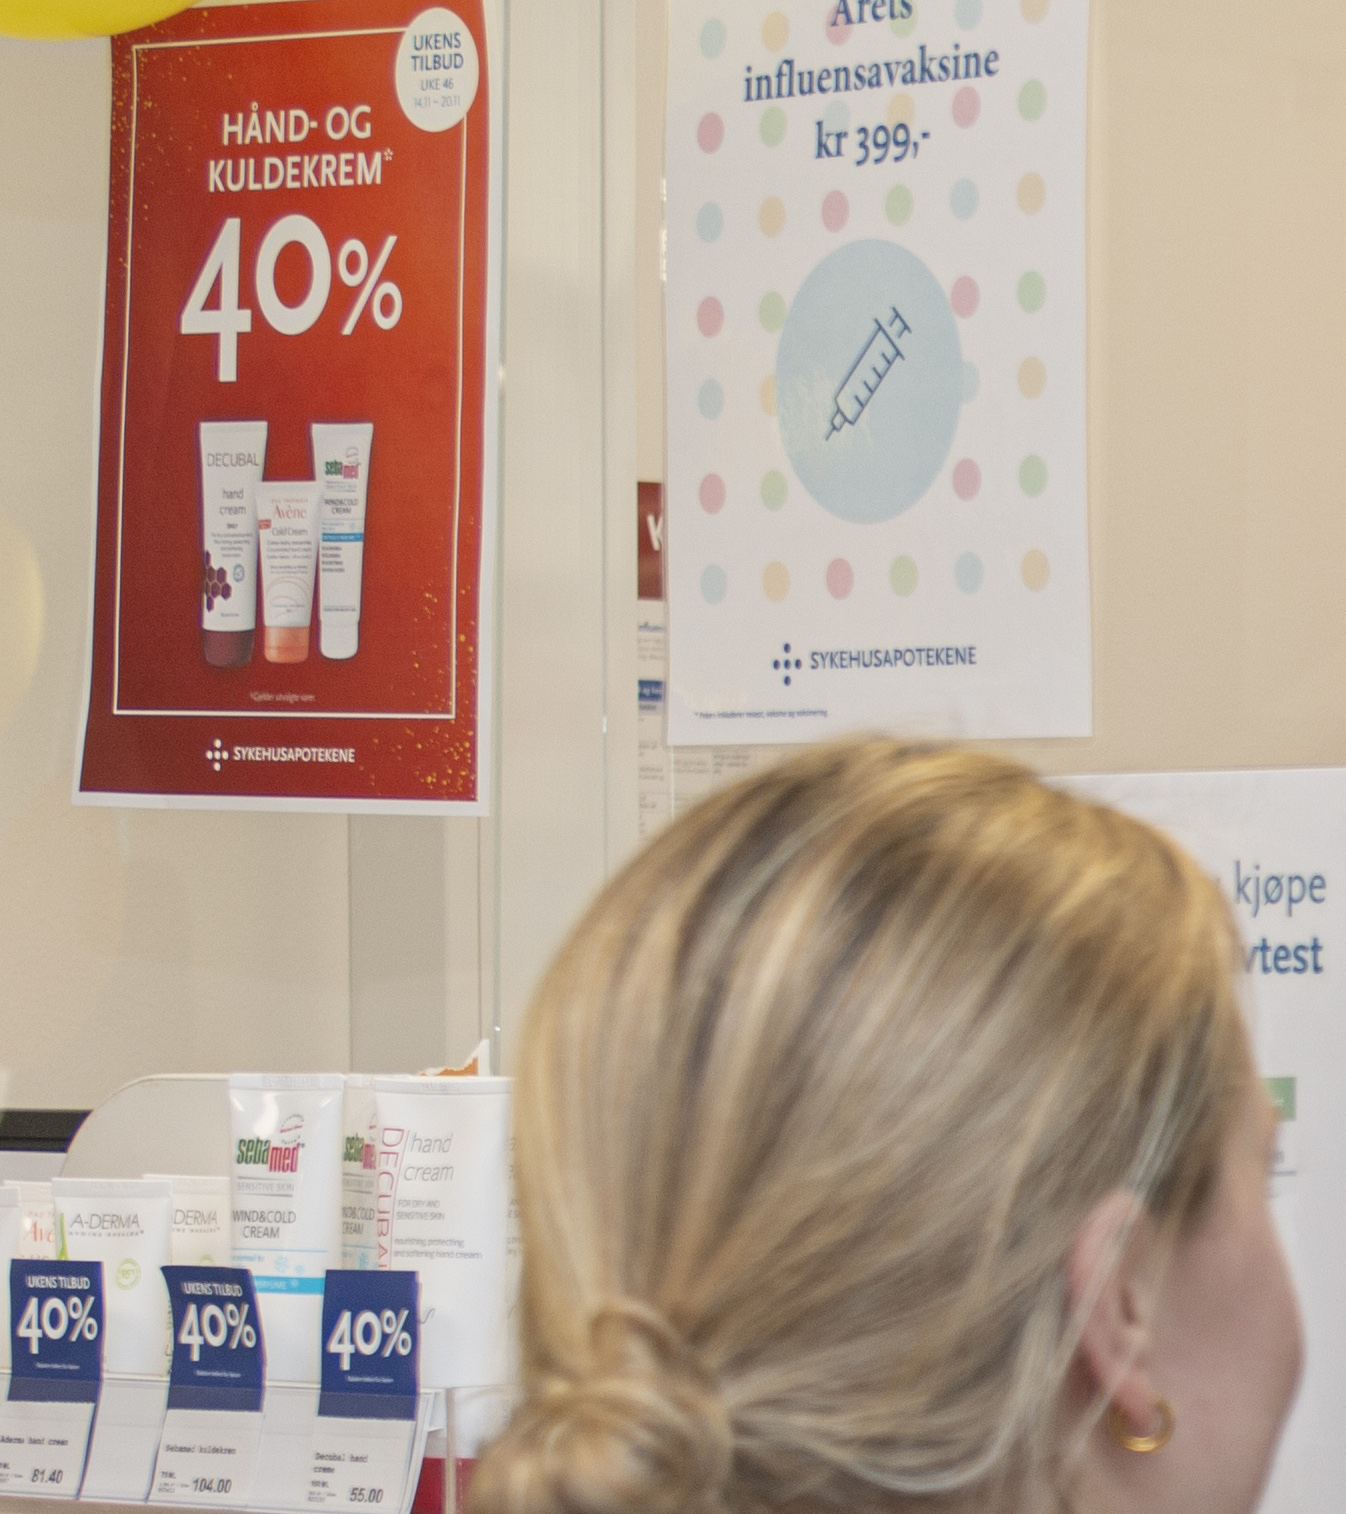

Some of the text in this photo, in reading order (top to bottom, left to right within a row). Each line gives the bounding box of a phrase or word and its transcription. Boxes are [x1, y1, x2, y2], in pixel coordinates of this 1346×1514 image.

[413, 32, 462, 51] UKENS
[410, 52, 464, 72] TILBUD
[743, 42, 1001, 103] influensavaksine
[420, 78, 454, 92] UKE 46
[222, 101, 372, 146] HÅND- OG
[814, 121, 932, 167] kr 399,-
[180, 214, 403, 383] 40%
[206, 452, 260, 469] DECUBAL
[221, 487, 245, 501] hand
[218, 504, 248, 516] cream
[809, 646, 978, 671] SYKEHUSAPOTEKENE
[233, 746, 356, 763] SYKEHUSAPOTEKENE
[1235, 861, 1327, 918] kjøpe
[410, 1131, 454, 1155] hand
[403, 1163, 455, 1182] cream
[69, 1213, 141, 1230] A-DERMA
[231, 1209, 297, 1225] WIND&COLD
[242, 1225, 281, 1240] CREAM
[27, 1274, 91, 1290] UKENS TILBUD
[183, 1281, 243, 1297] UKENS TILBUD
[16, 1295, 98, 1355] 40%
[178, 1301, 257, 1363] 40%
[327, 1307, 412, 1372] 40%
[30, 1468, 63, 1485] 81.40
[192, 1477, 232, 1494] 104.00
[349, 1487, 384, 1503] 55.00
